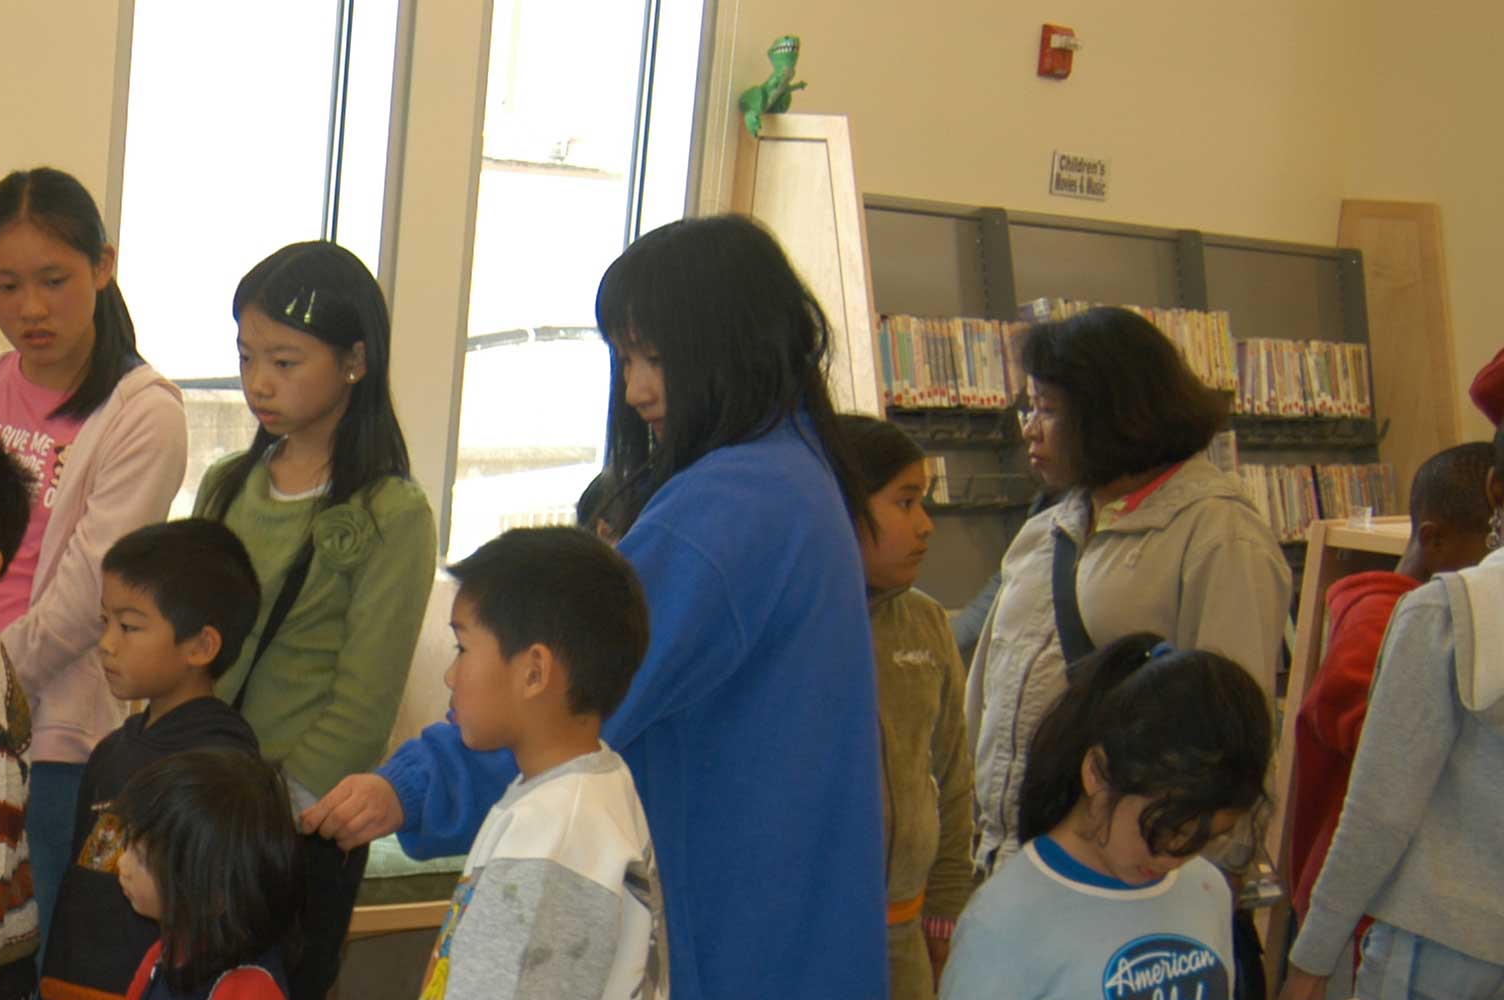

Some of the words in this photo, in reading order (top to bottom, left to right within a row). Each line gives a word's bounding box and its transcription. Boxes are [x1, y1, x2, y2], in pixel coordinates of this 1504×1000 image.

[1059, 154, 1105, 176] Children's
[1, 425, 30, 452] GIVE
[30, 431, 55, 457] ME
[1105, 950, 1215, 996] American
